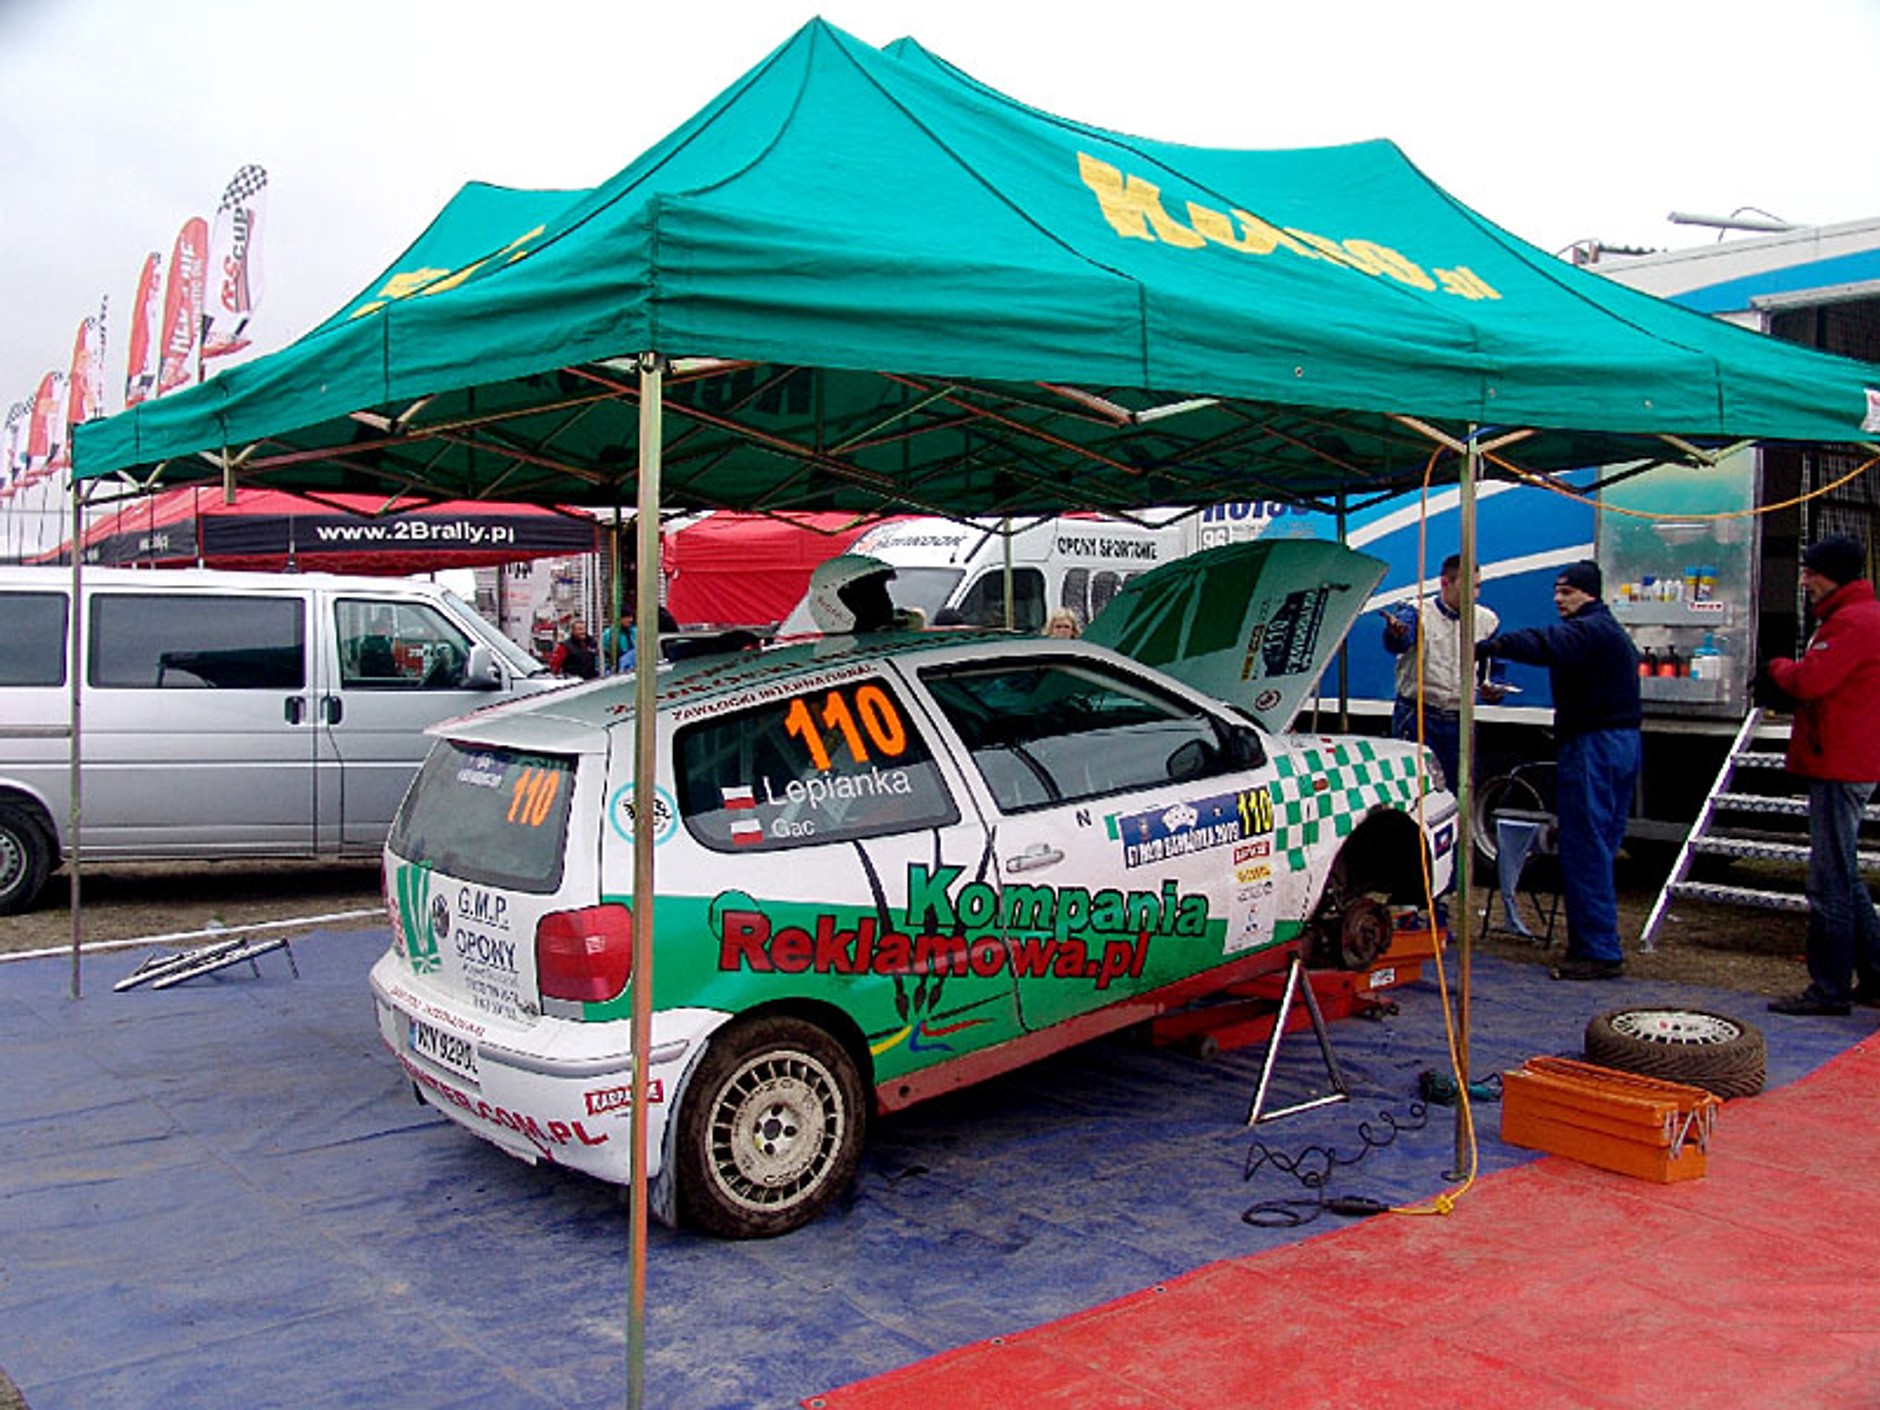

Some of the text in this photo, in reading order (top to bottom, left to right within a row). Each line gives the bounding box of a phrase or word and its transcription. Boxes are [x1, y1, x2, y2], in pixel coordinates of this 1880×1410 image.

[784, 685, 907, 771] 110
[507, 768, 561, 828] 110
[763, 766, 912, 808] Lepianka
[771, 817, 815, 837] Gac
[1076, 811, 1092, 827] N
[1238, 789, 1273, 836] 110
[905, 862, 1209, 938] Kompania
[455, 929, 517, 969] OPONY
[718, 909, 1152, 990] Reklamowa.pl
